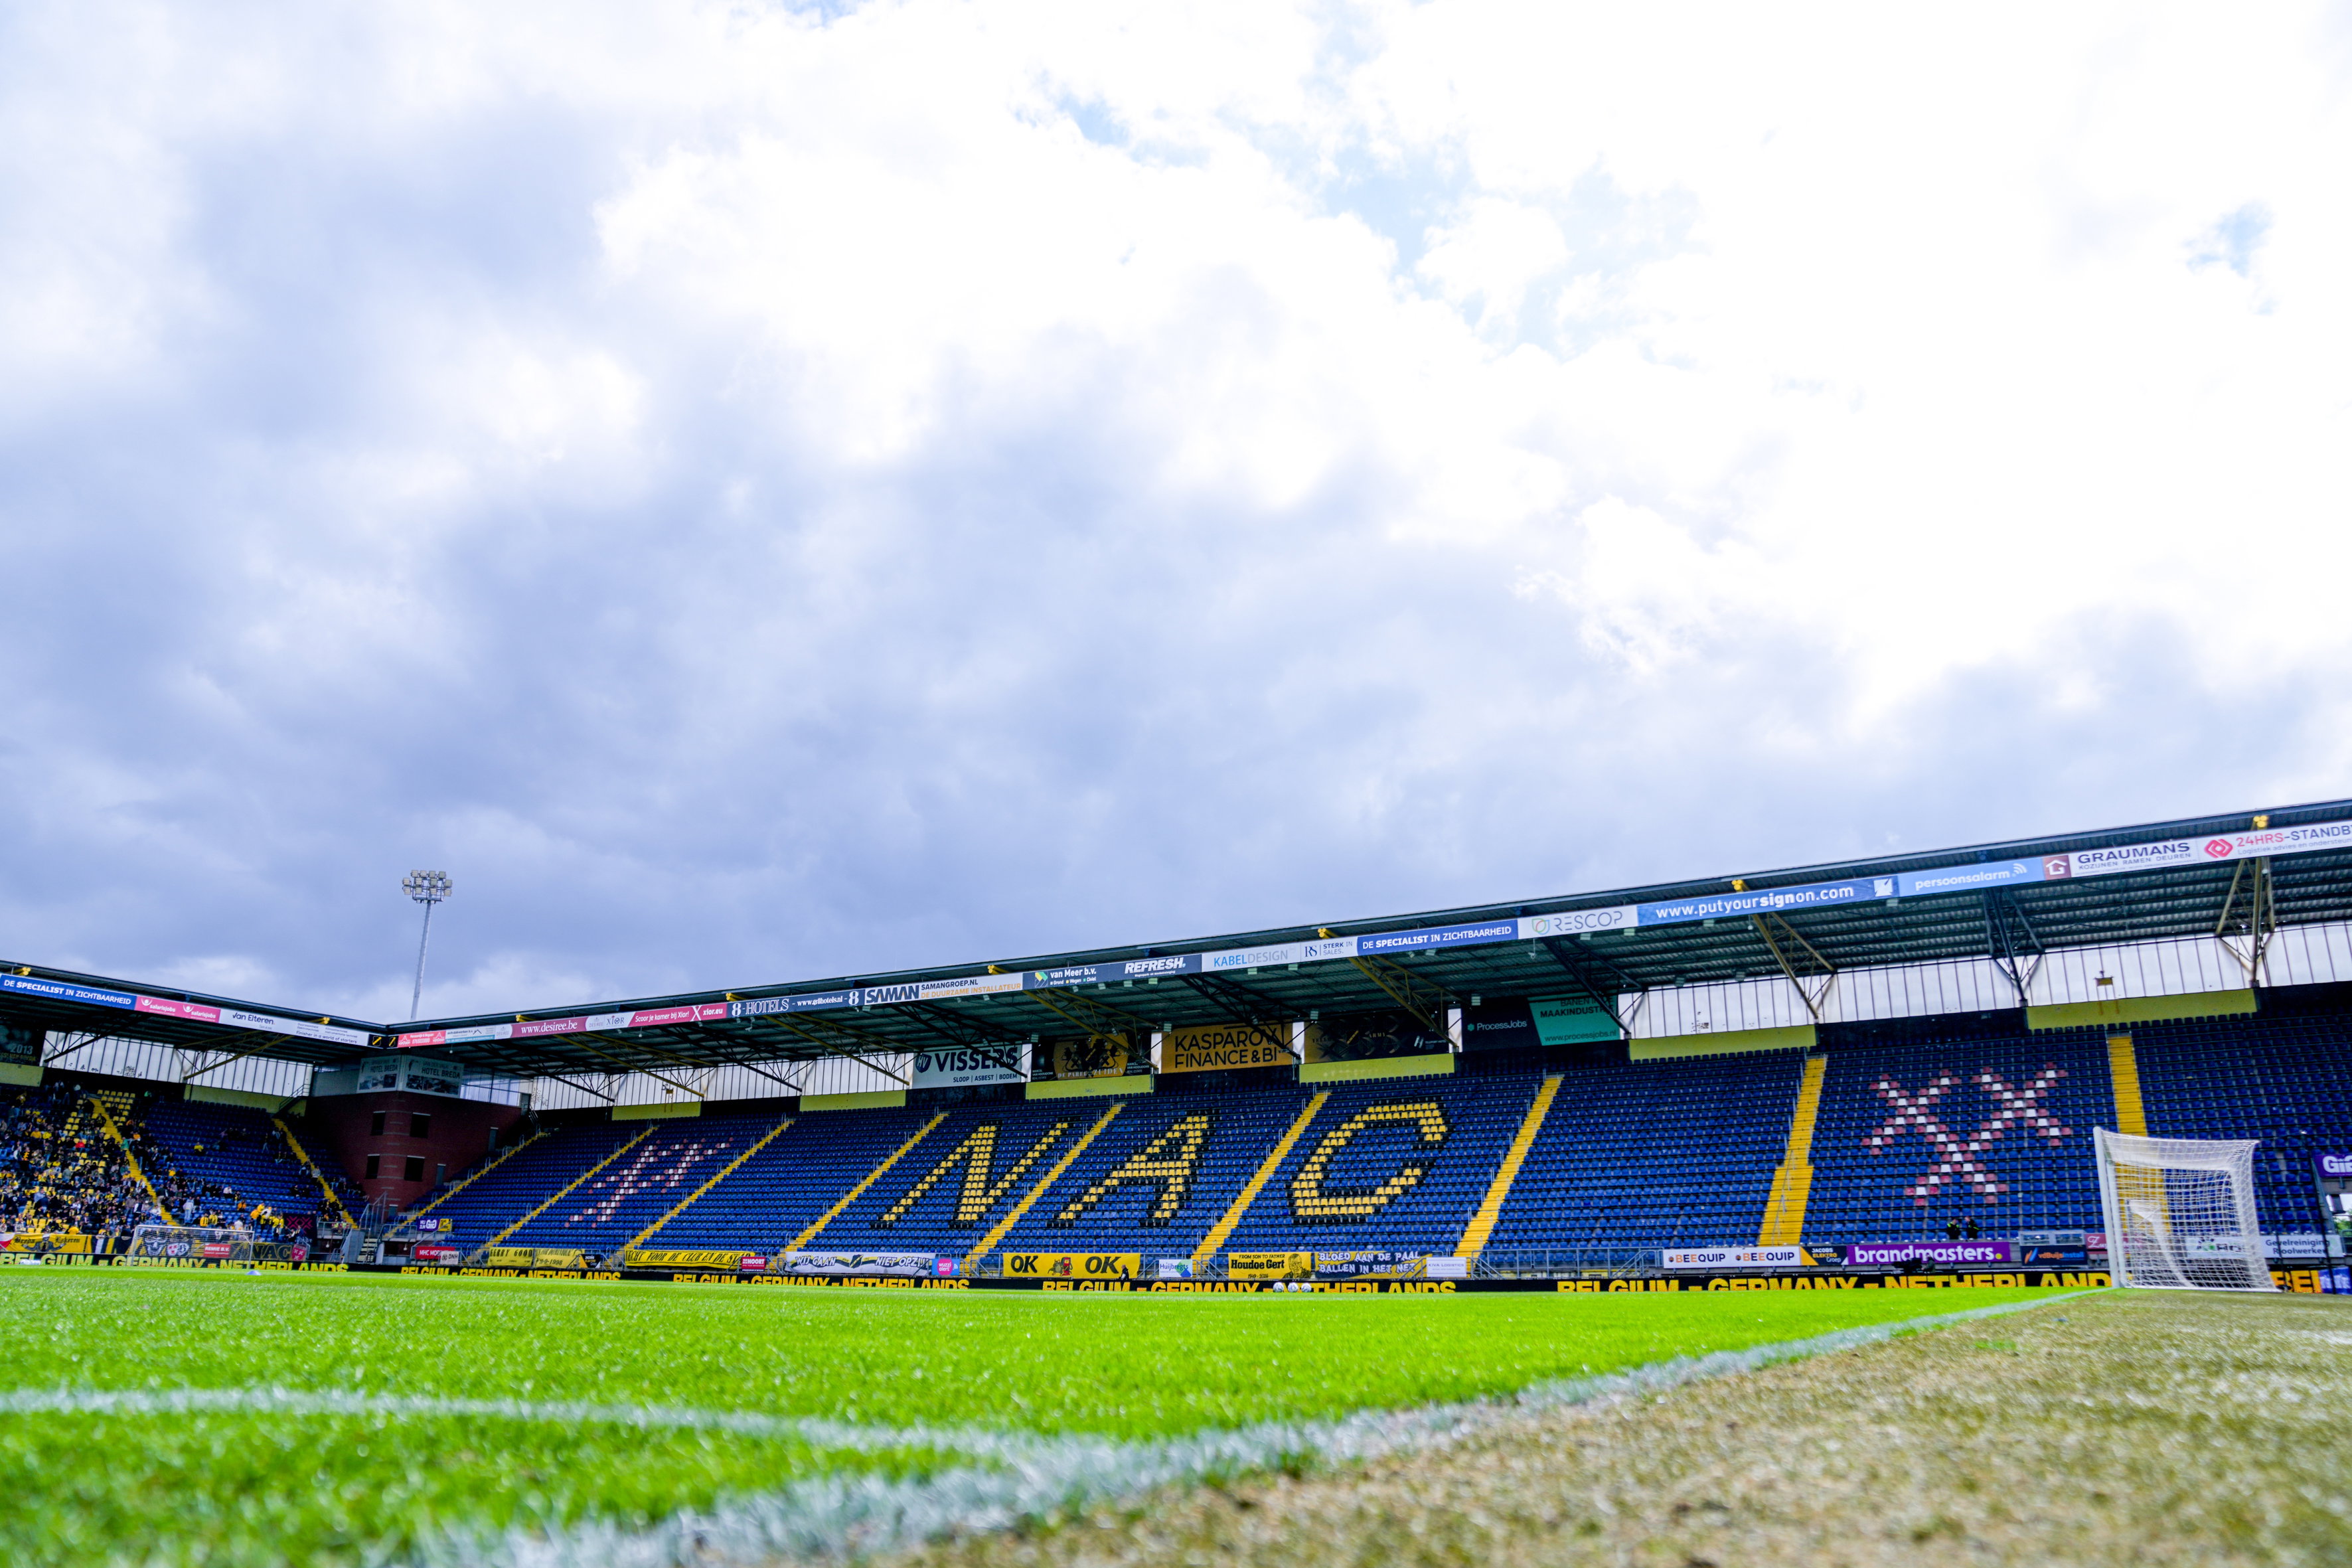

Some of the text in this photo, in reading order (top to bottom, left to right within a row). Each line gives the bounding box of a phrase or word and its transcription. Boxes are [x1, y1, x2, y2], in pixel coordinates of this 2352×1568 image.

[2236, 824, 2352, 848] 24HRS-STANDB
[2078, 842, 2190, 864] GRAUMANS
[2078, 861, 2118, 870] KOZIJNEN
[2123, 857, 2152, 866] RAMEN
[2156, 853, 2191, 862] DEUREN
[1915, 870, 2011, 892] persoonsalarm
[1656, 886, 1855, 919] www.putyoursignon.com
[1553, 910, 1623, 932] RESCOP
[1363, 926, 1512, 949] DE SPECIALIST IN ZICHTBAARHEID
[1214, 949, 1289, 968] KABELDESIGN
[1064, 969, 1083, 978] Meer
[1084, 967, 1097, 976] b.v.
[4, 979, 15, 988] DE
[16, 982, 64, 994] SPECIALIST
[75, 990, 131, 1005] ZICHTBAARHEID
[921, 979, 979, 991] SAMANGROEP.NL
[931, 988, 969, 998] DUURZAME
[971, 983, 1021, 994] INSTALLATEUR
[866, 984, 919, 1004] SAMAN
[149, 1004, 176, 1013] salarisjobs
[745, 998, 789, 1015] HOTELS
[1561, 997, 1589, 1007] BANEN
[191, 1010, 216, 1020] salarisjobs
[649, 1014, 654, 1022] je
[655, 1012, 670, 1021] kamer
[702, 1008, 723, 1016] xior.eu
[1540, 1004, 1615, 1018] MAAKINDUSTRE
[521, 1020, 578, 1034] www.desiree.be
[1476, 1020, 1528, 1032] ProcessJobs
[1544, 1030, 1616, 1042] www.processjobs.nl
[10, 1043, 33, 1055] 2013
[1175, 1049, 1248, 1068] FINANCE
[422, 1067, 439, 1075] HOTEL
[441, 1070, 461, 1079] BREDA
[252, 1243, 293, 1260] NAC
[668, 1253, 682, 1262] DE
[682, 1252, 704, 1262] CLUB
[1318, 1251, 1421, 1263] BLOED AAN DE PAAL
[1676, 1251, 1795, 1263] BEEQUIP BEEQUIP
[795, 1254, 811, 1266] WIJ
[812, 1255, 837, 1267] GAAN
[874, 1255, 898, 1267] NIET
[1010, 1255, 1122, 1275] OK OK
[1231, 1259, 1285, 1270] Houdoe Gert
[1318, 1263, 1416, 1275] BALLEN IN HET NET
[1884, 1273, 2113, 1289] NETHERLAND
